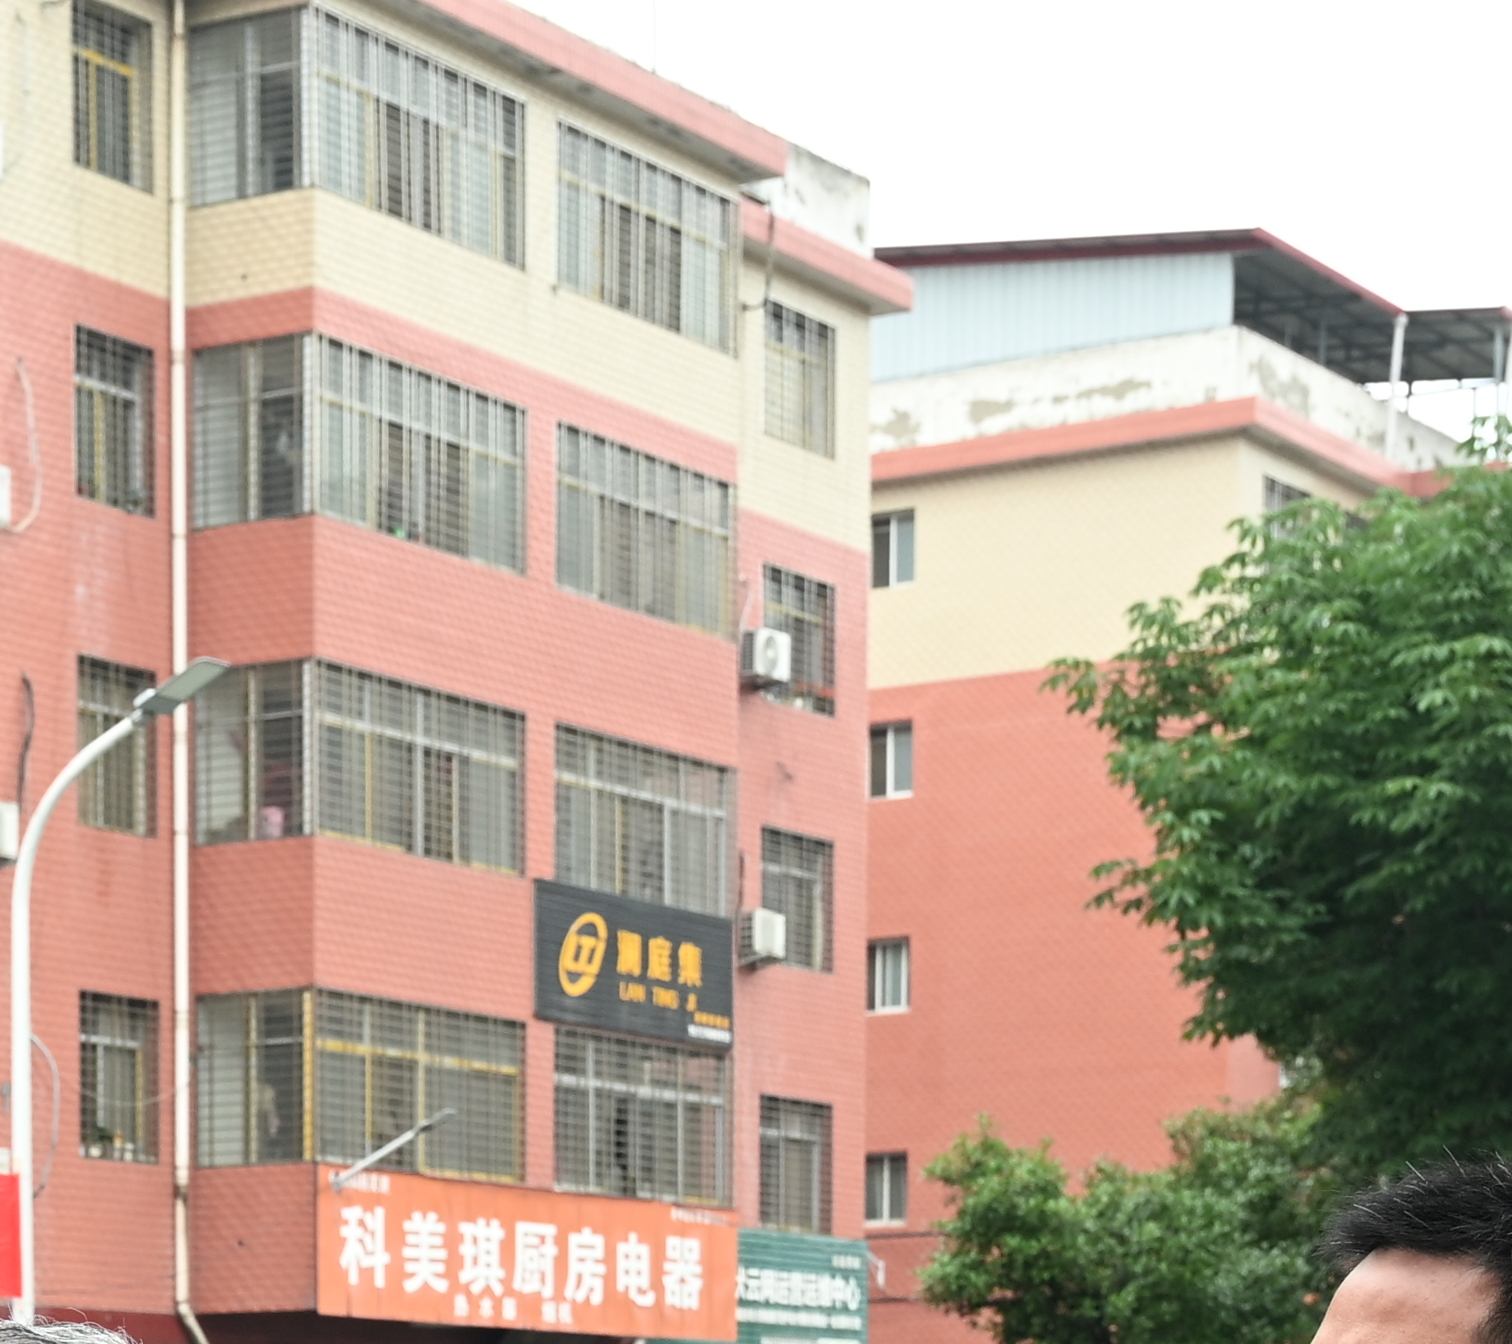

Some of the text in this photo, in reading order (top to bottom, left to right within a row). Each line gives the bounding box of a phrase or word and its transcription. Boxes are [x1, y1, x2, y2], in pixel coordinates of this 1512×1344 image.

[339, 1205, 703, 1310] 科美琪厨房电器
